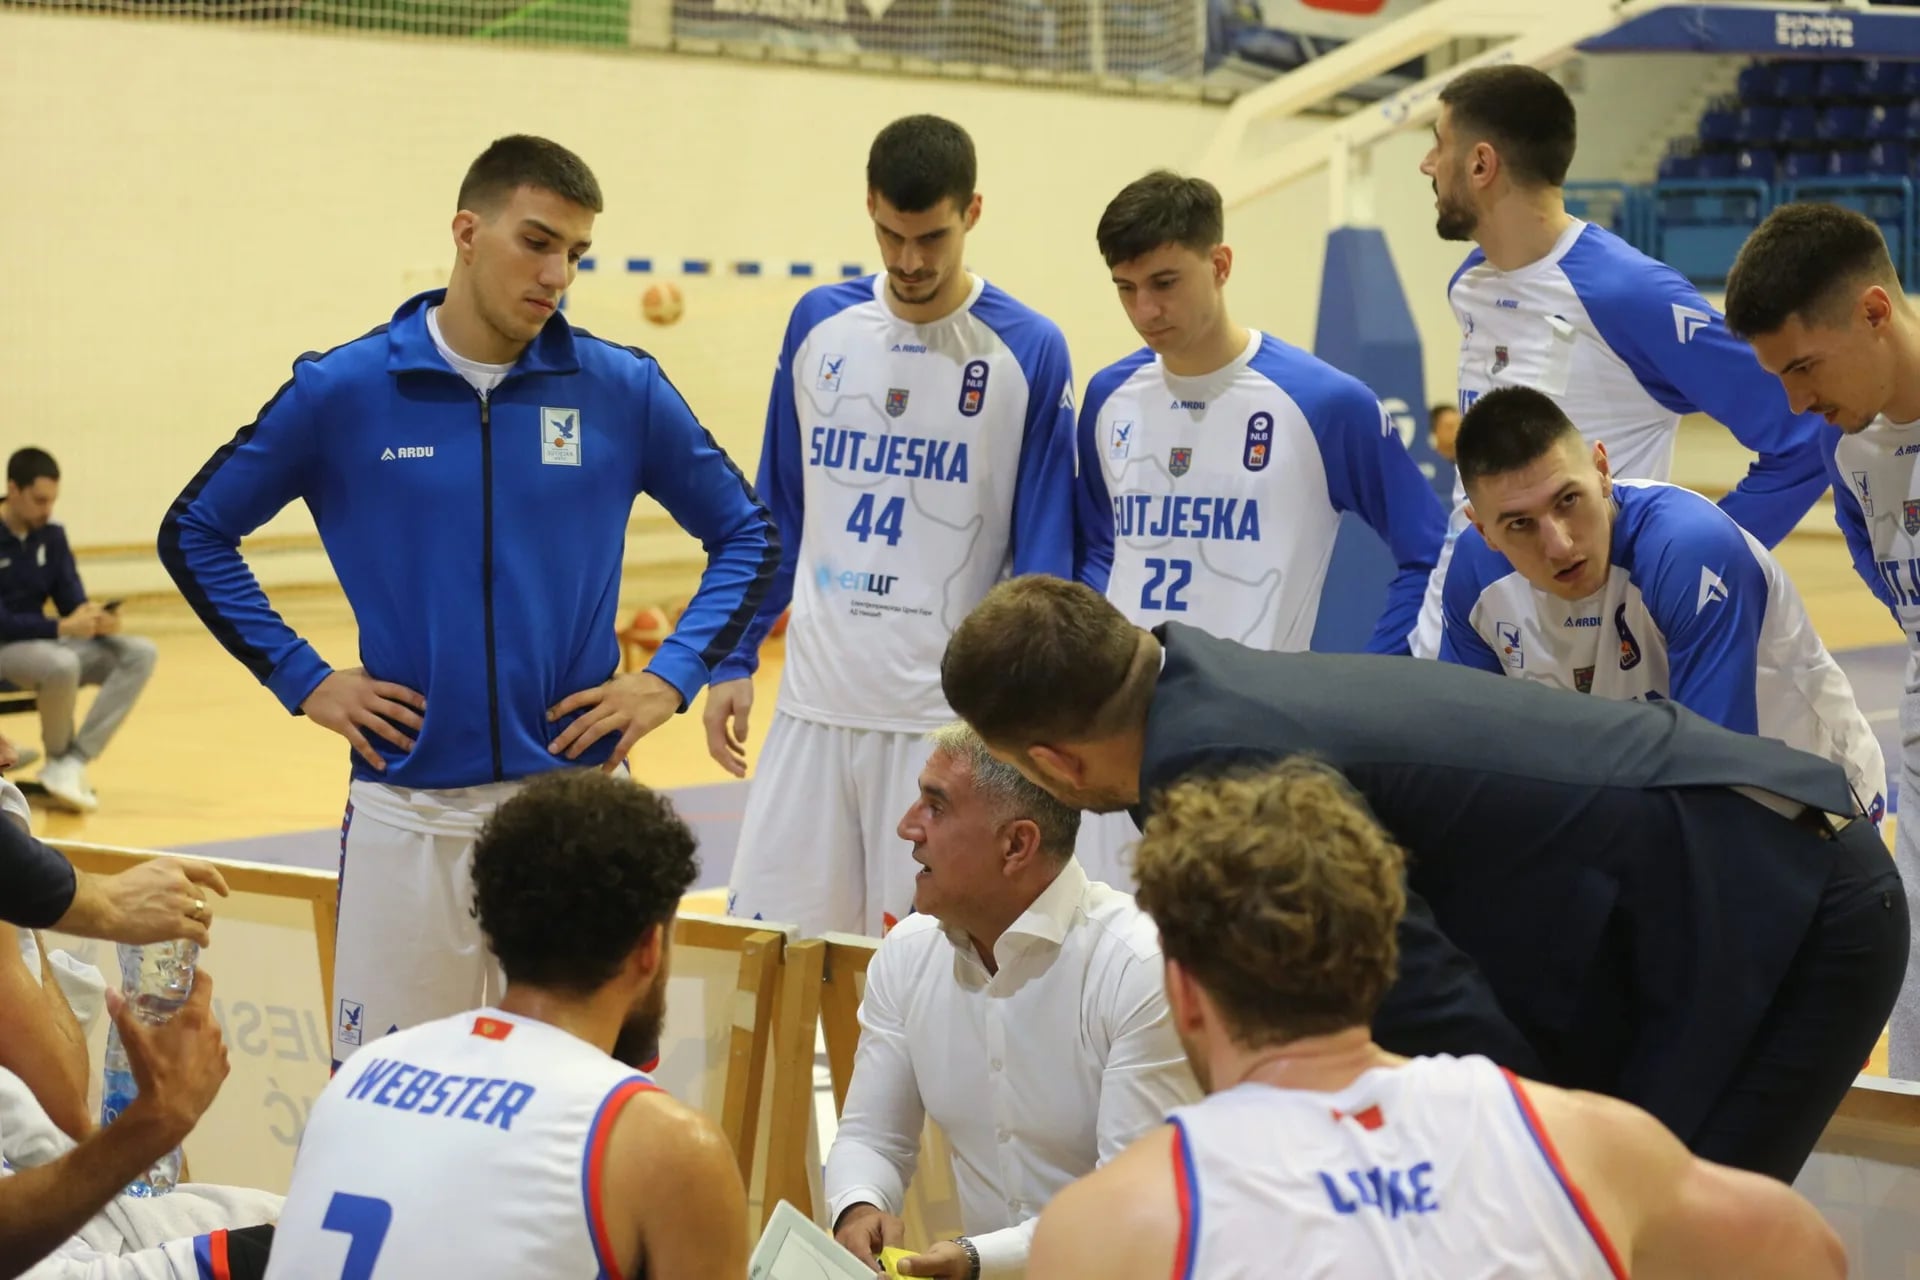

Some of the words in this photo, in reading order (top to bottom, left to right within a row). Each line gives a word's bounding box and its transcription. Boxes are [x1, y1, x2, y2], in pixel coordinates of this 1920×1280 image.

[397, 446, 434, 459] ARDU
[810, 426, 969, 484] SUTJESKA
[845, 492, 906, 547] 44
[1140, 558, 1193, 612] 22
[346, 1058, 537, 1131] WEBSTER
